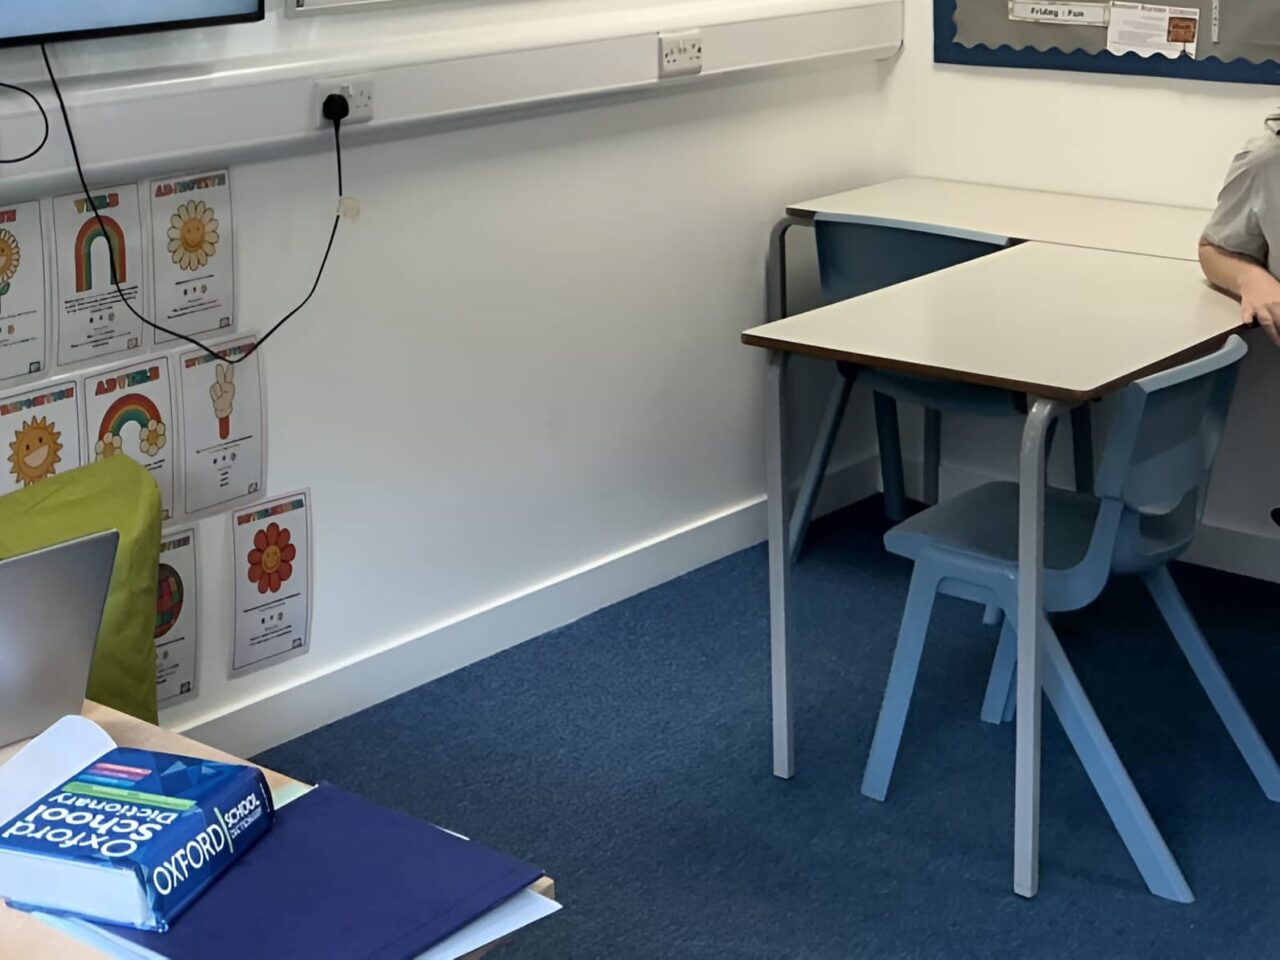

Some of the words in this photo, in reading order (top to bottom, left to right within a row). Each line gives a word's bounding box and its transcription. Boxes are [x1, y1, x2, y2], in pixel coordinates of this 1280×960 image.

[1031, 7, 1058, 17] Friday
[23, 804, 163, 841] School
[48, 793, 178, 825] Dictionary
[224, 793, 261, 827] SCHOOL
[2, 821, 138, 858] Oxford
[153, 823, 227, 896] OXFORD
